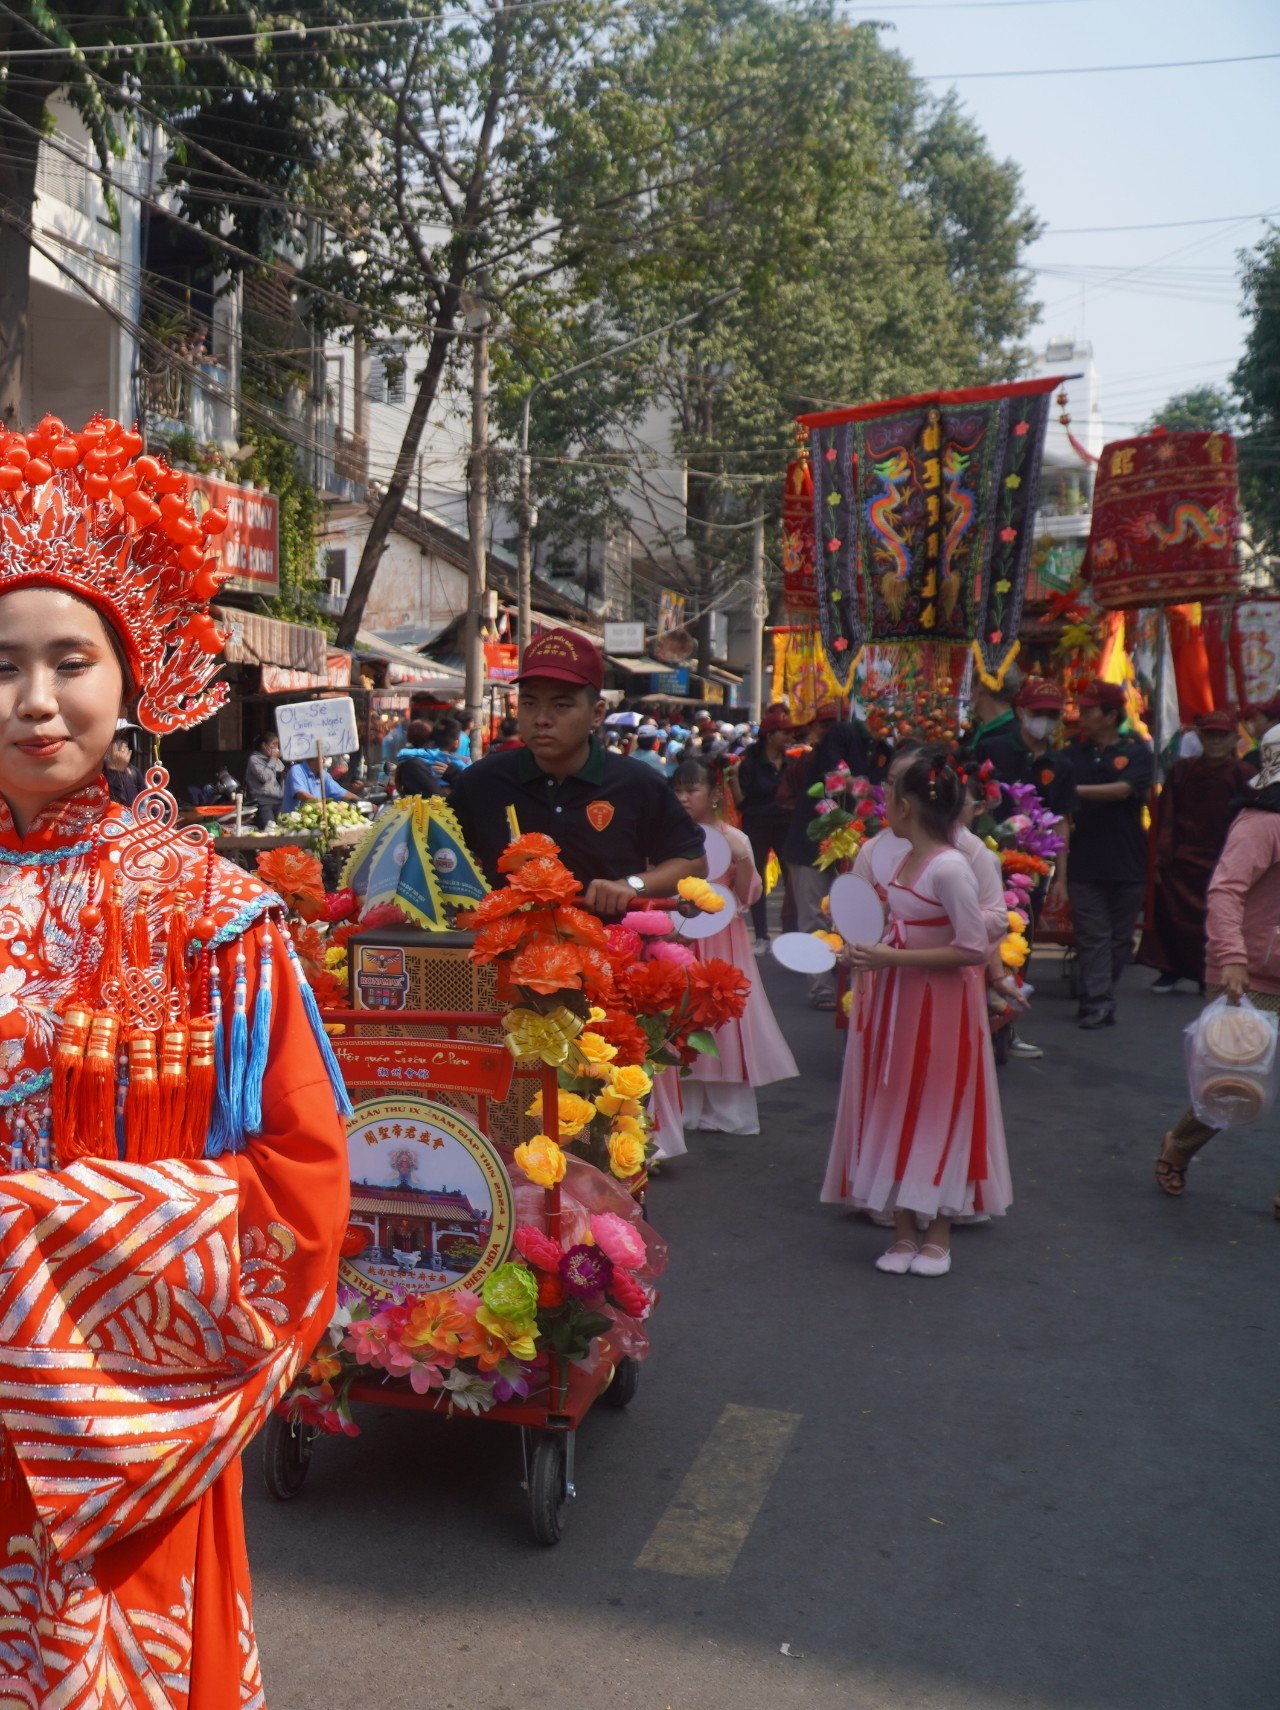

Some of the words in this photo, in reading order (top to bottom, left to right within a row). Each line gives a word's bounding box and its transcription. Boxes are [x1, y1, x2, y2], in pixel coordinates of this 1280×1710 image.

[247, 501, 273, 530] QUAY
[249, 545, 273, 574] KINH
[409, 1106, 421, 1115] IX
[494, 1182, 505, 1215] 2024
